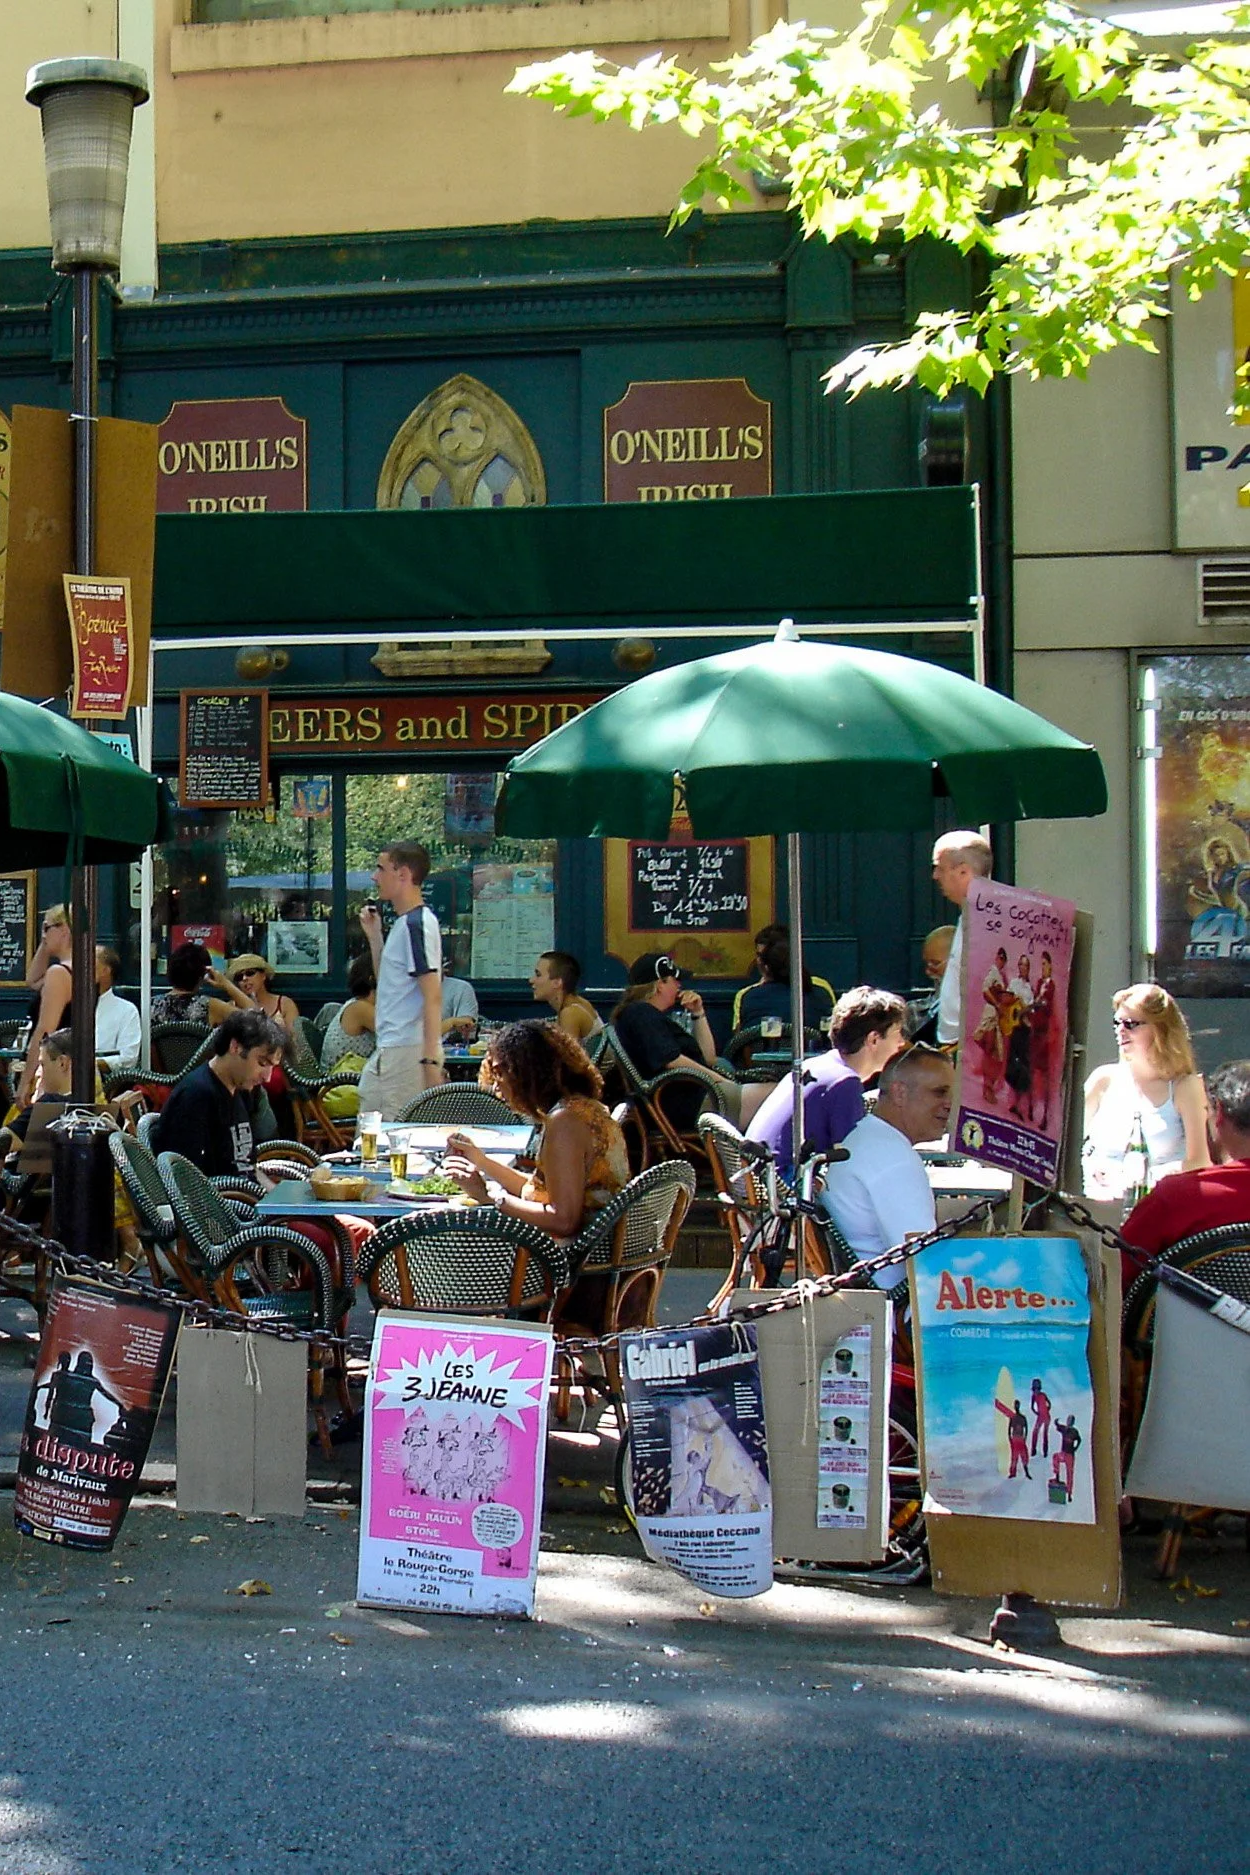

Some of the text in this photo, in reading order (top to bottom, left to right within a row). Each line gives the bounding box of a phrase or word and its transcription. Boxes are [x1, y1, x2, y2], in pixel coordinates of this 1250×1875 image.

[158, 436, 299, 475] O'NEILL'S
[610, 425, 764, 464] O'NEILL'S
[395, 704, 469, 742] and
[975, 892, 1002, 917] Les
[443, 1361, 474, 1379] LES
[627, 1340, 697, 1380] Gabriel
[401, 1376, 508, 1408] 3 JEANNE
[35, 1435, 135, 1480] dispute
[36, 1465, 108, 1492] de Marivaux
[383, 1556, 475, 1579] le Rouge-Gorge
[407, 1546, 453, 1563] Théâtre
[420, 1582, 441, 1595] 22h
